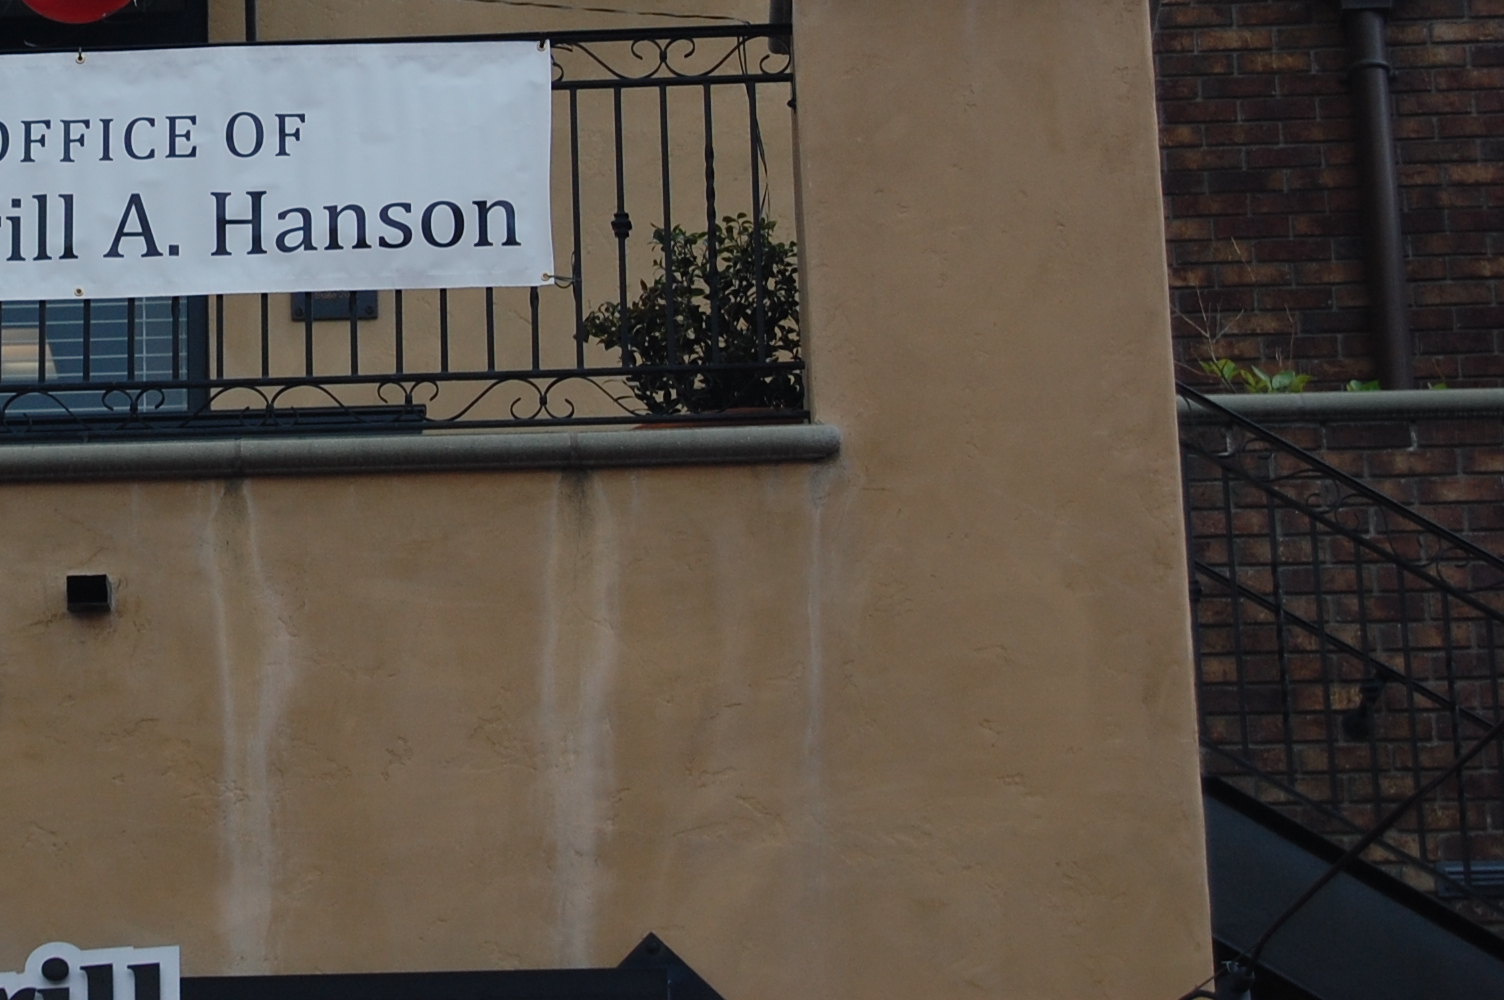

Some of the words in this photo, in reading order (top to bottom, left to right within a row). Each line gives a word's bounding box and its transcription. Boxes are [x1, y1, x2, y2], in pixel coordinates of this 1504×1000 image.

[224, 110, 307, 159] OF
[102, 192, 180, 258] A.
[209, 190, 523, 257] Hanson
